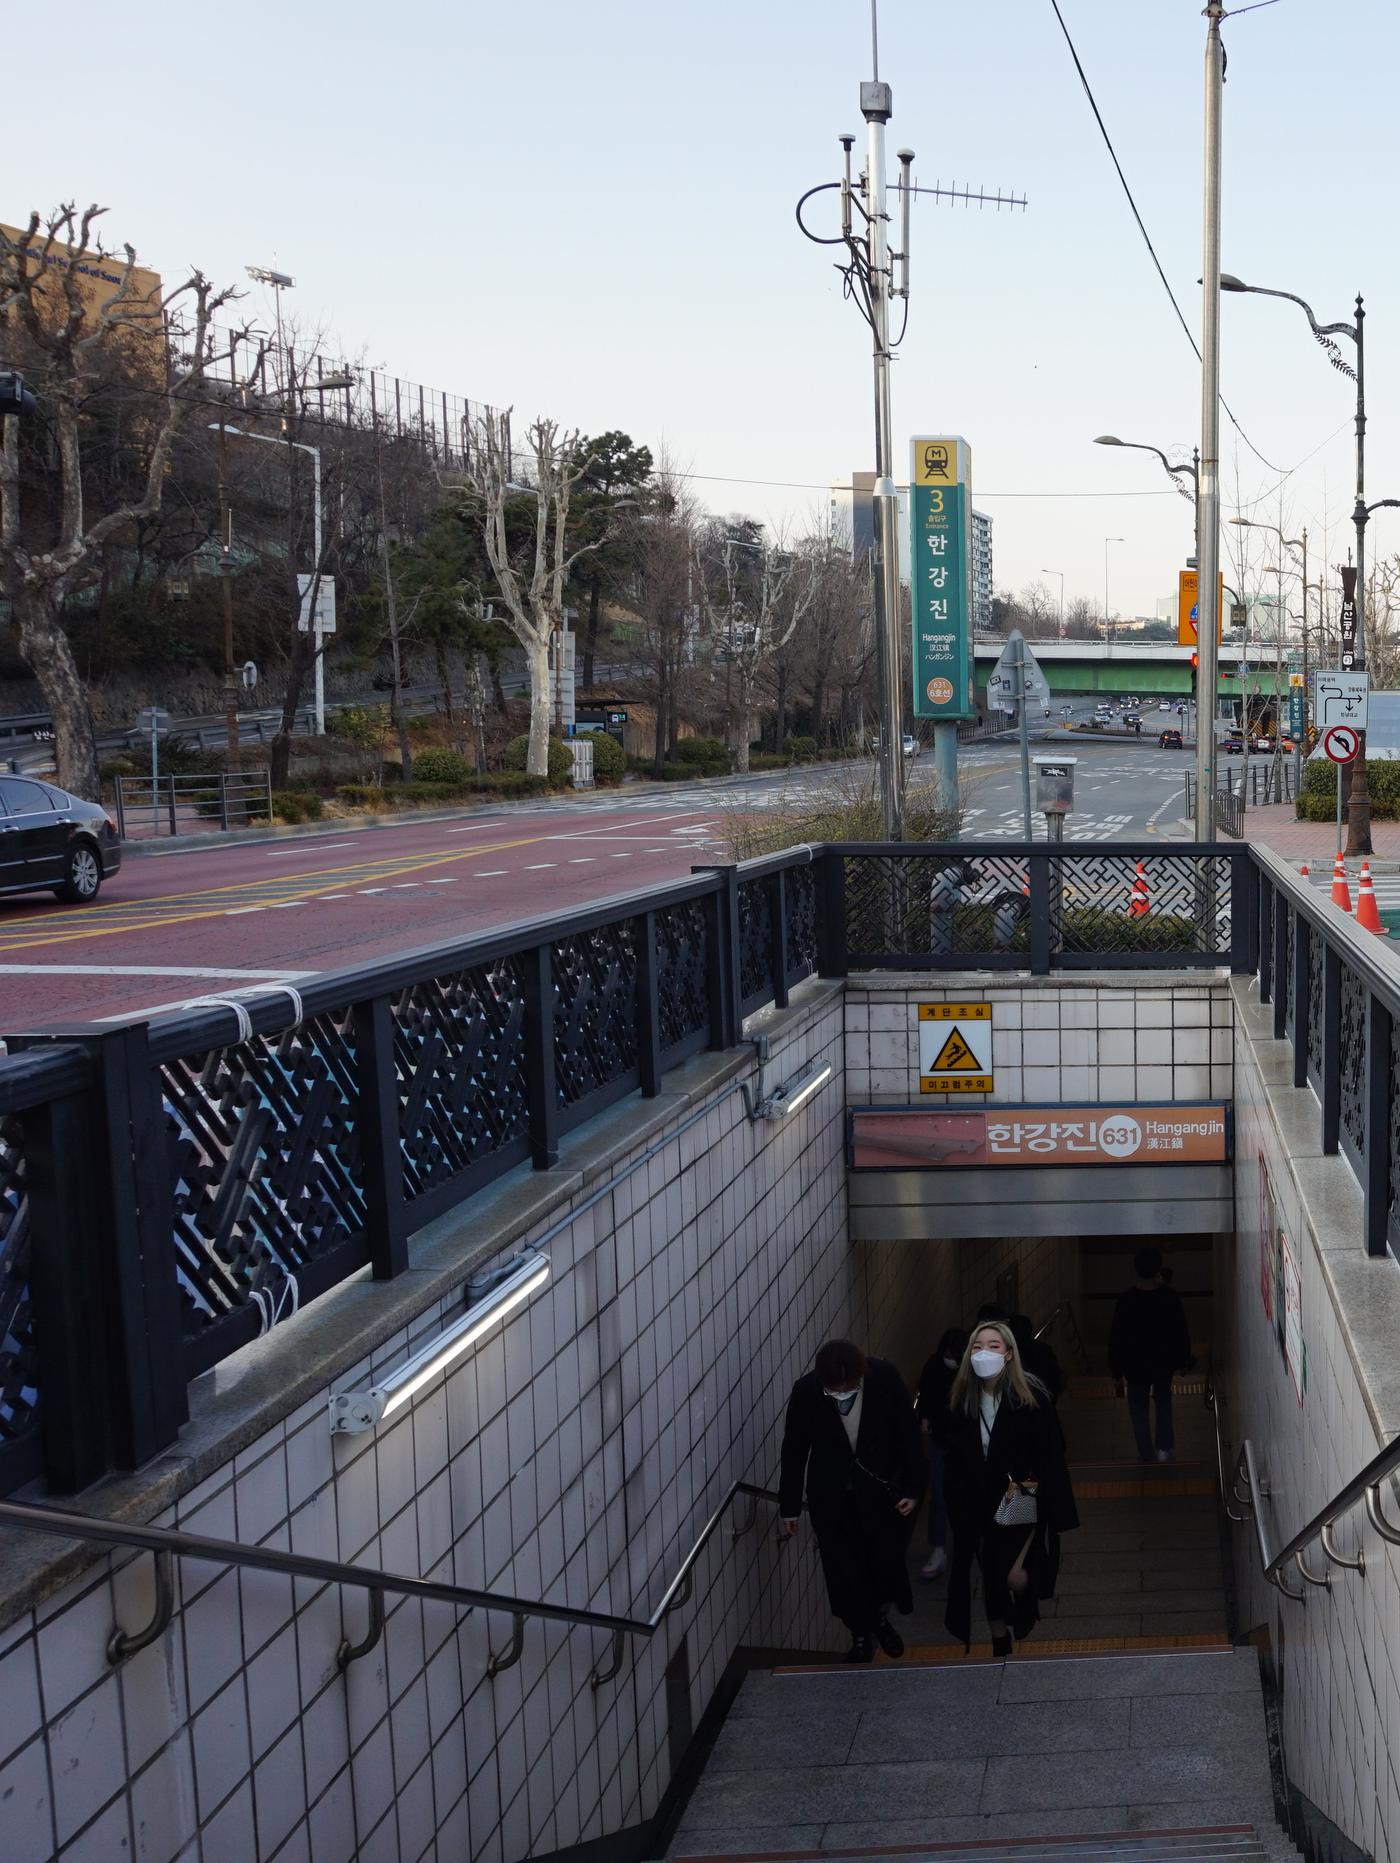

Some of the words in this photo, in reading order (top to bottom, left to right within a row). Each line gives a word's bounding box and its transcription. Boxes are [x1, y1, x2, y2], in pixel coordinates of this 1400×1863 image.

[931, 449, 941, 458] M
[929, 489, 944, 513] 3
[927, 534, 948, 620] 한강진
[922, 632, 956, 644] Hangangjin
[987, 1120, 1097, 1153] 한강진
[1103, 1127, 1140, 1146] 631
[1146, 1120, 1224, 1136] Hangangjin
